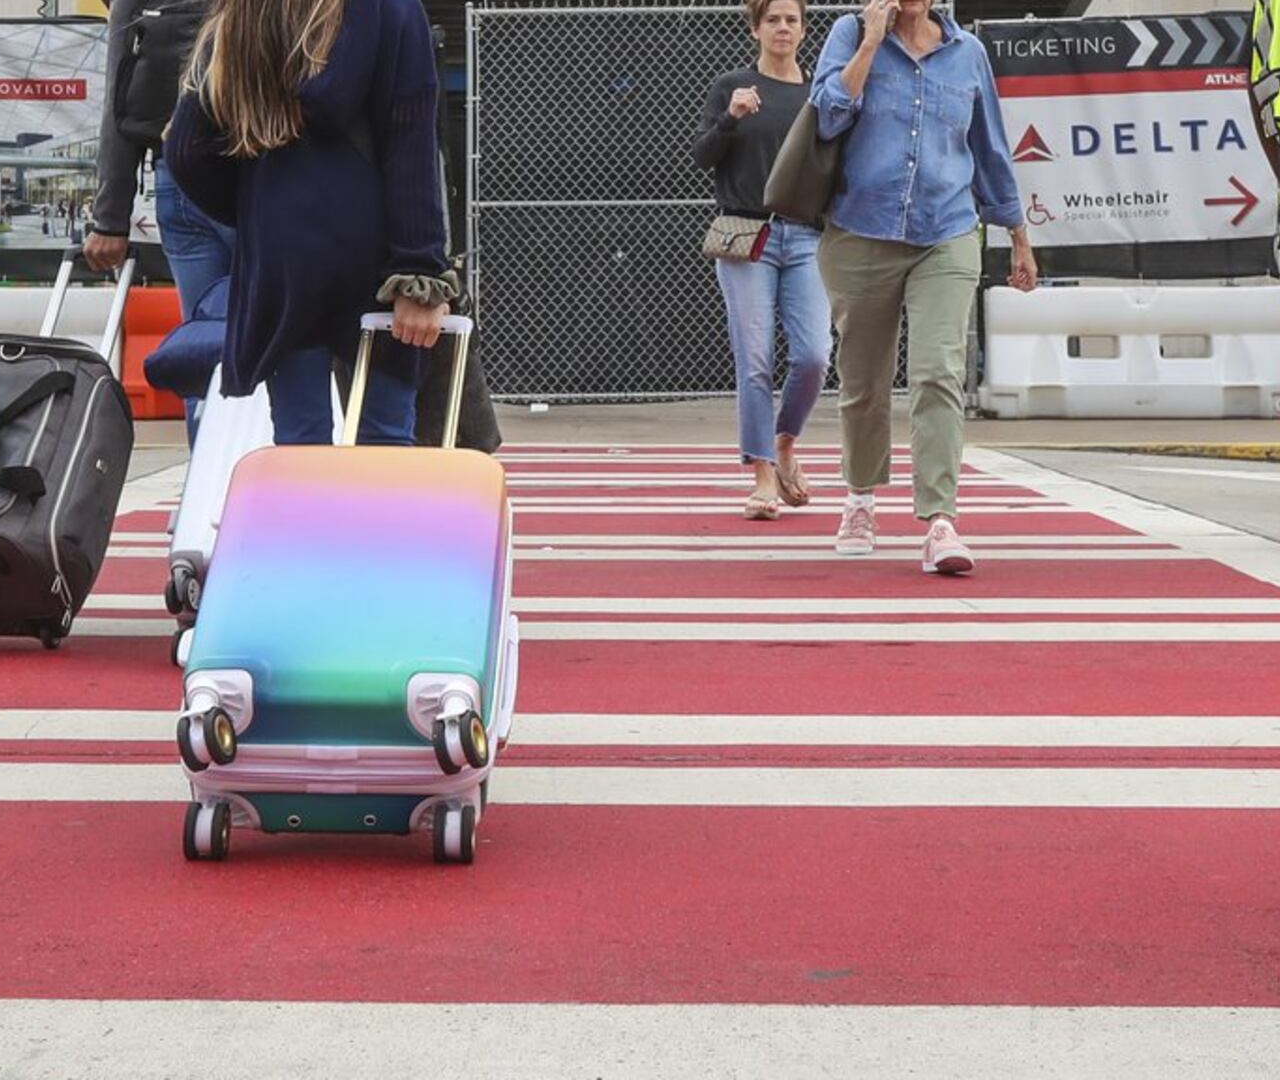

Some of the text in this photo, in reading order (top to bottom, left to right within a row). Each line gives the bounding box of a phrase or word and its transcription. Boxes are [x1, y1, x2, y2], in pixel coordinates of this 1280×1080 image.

[992, 36, 1116, 57] TICKETING
[1071, 119, 1247, 156] DELTA
[1063, 190, 1170, 208] Wheelchair
[1064, 207, 1170, 221] Special Assistance
